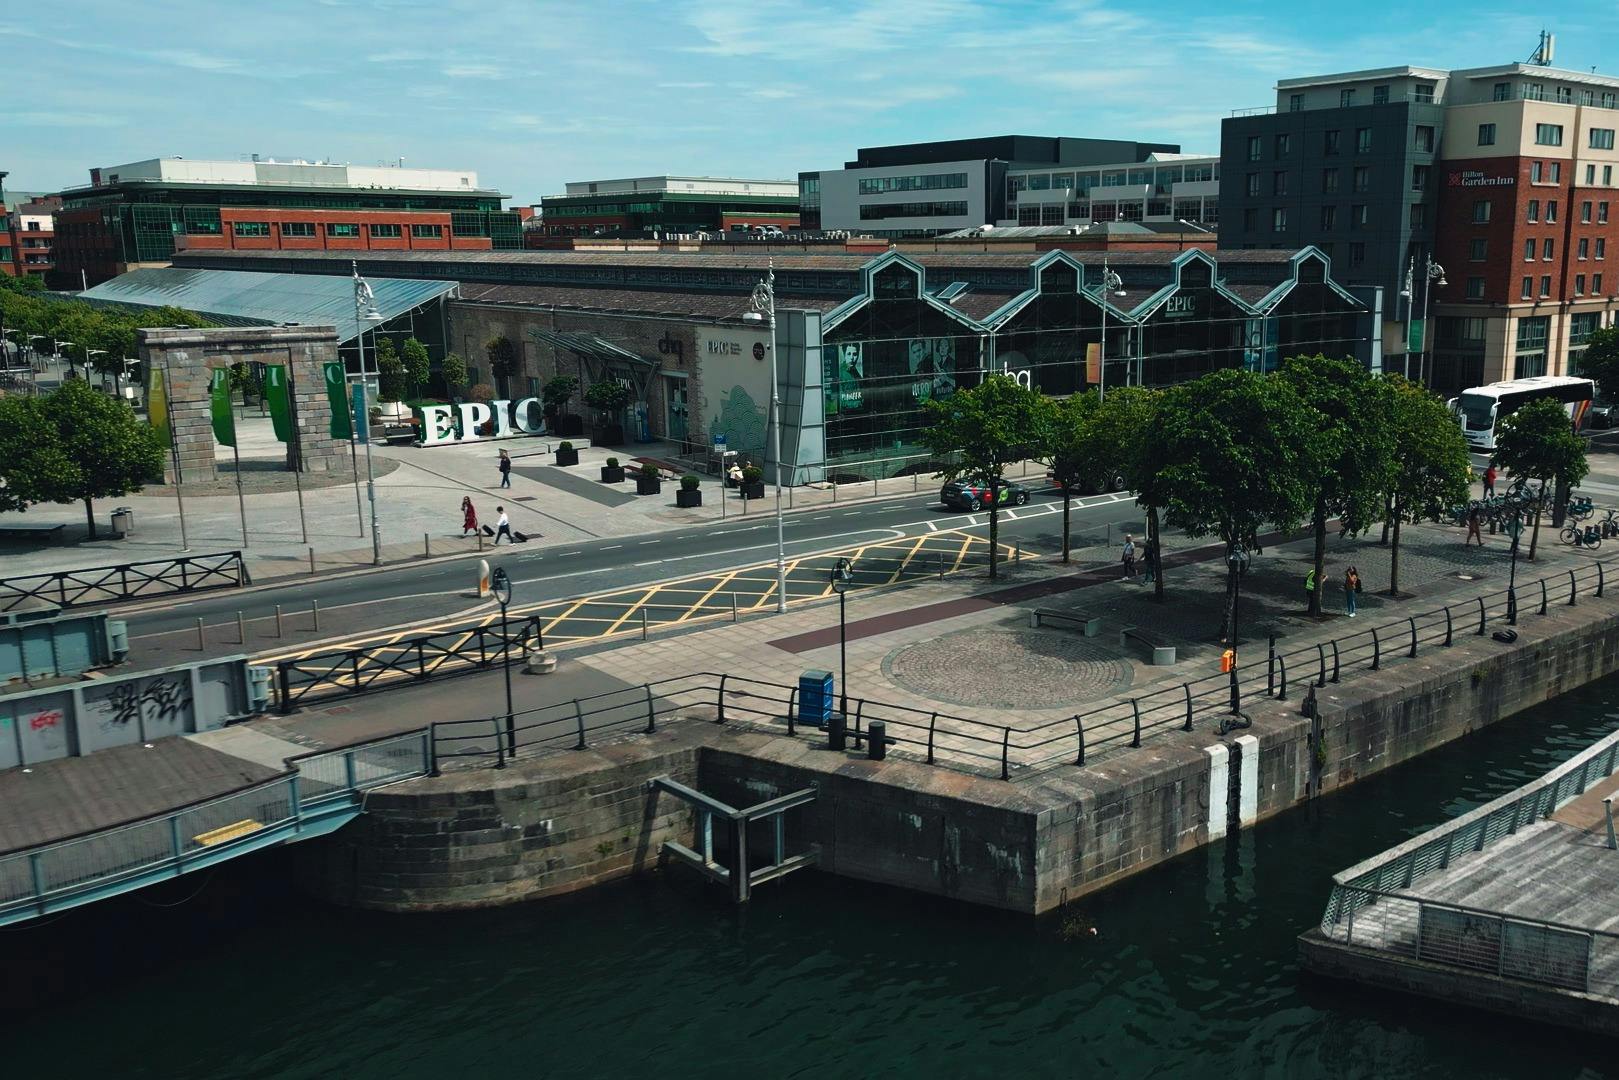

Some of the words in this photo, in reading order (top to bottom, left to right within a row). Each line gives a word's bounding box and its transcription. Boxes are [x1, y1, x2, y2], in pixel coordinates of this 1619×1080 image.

[1462, 177, 1495, 186] Garden
[1497, 177, 1514, 185] Inn
[1166, 296, 1195, 311] EPIC
[326, 365, 342, 384] C
[998, 361, 1031, 391] hq
[421, 397, 546, 444] EPIC
